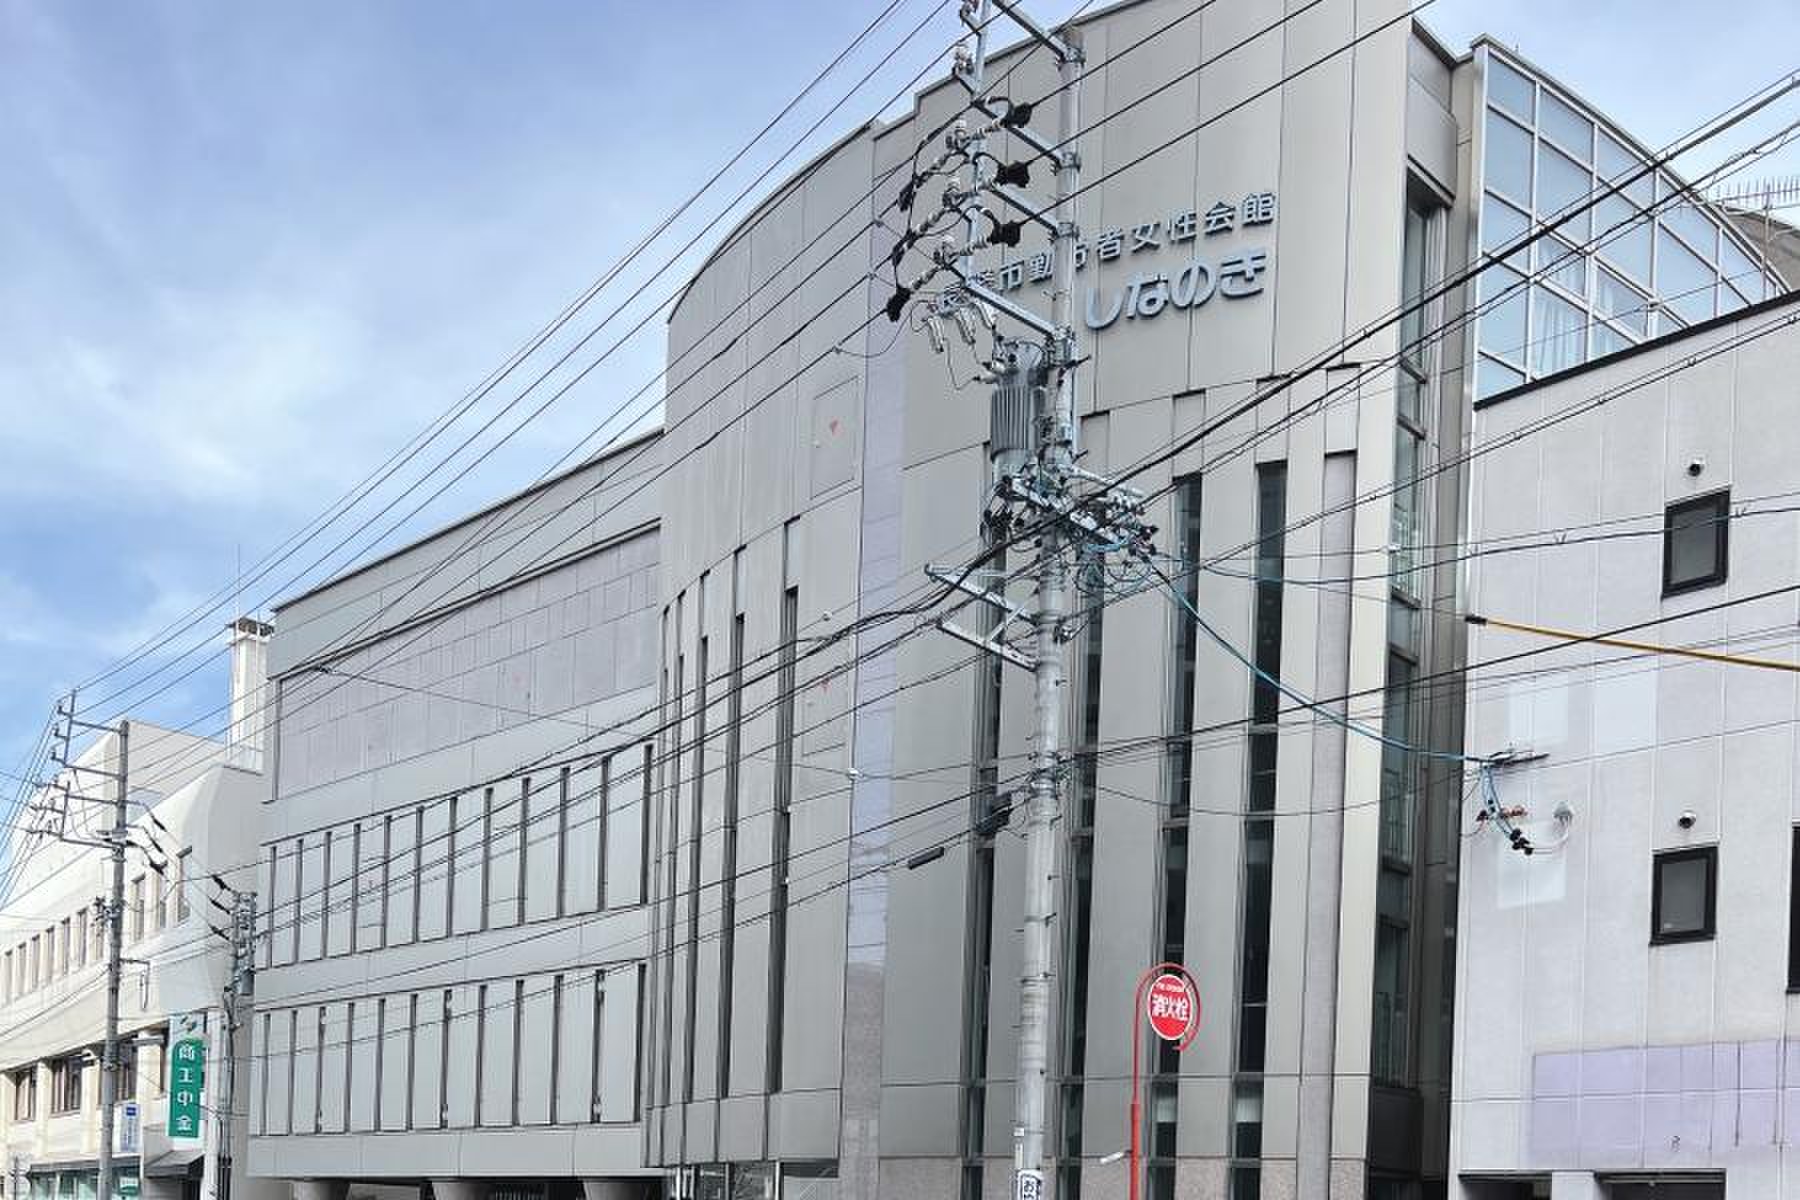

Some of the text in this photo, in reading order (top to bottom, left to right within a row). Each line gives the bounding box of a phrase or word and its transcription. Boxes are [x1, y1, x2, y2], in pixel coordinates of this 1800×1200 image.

[1085, 248, 1268, 330] しなのき
[1152, 993, 1188, 1021] 消火栓
[175, 1043, 195, 1132] 商工中金
